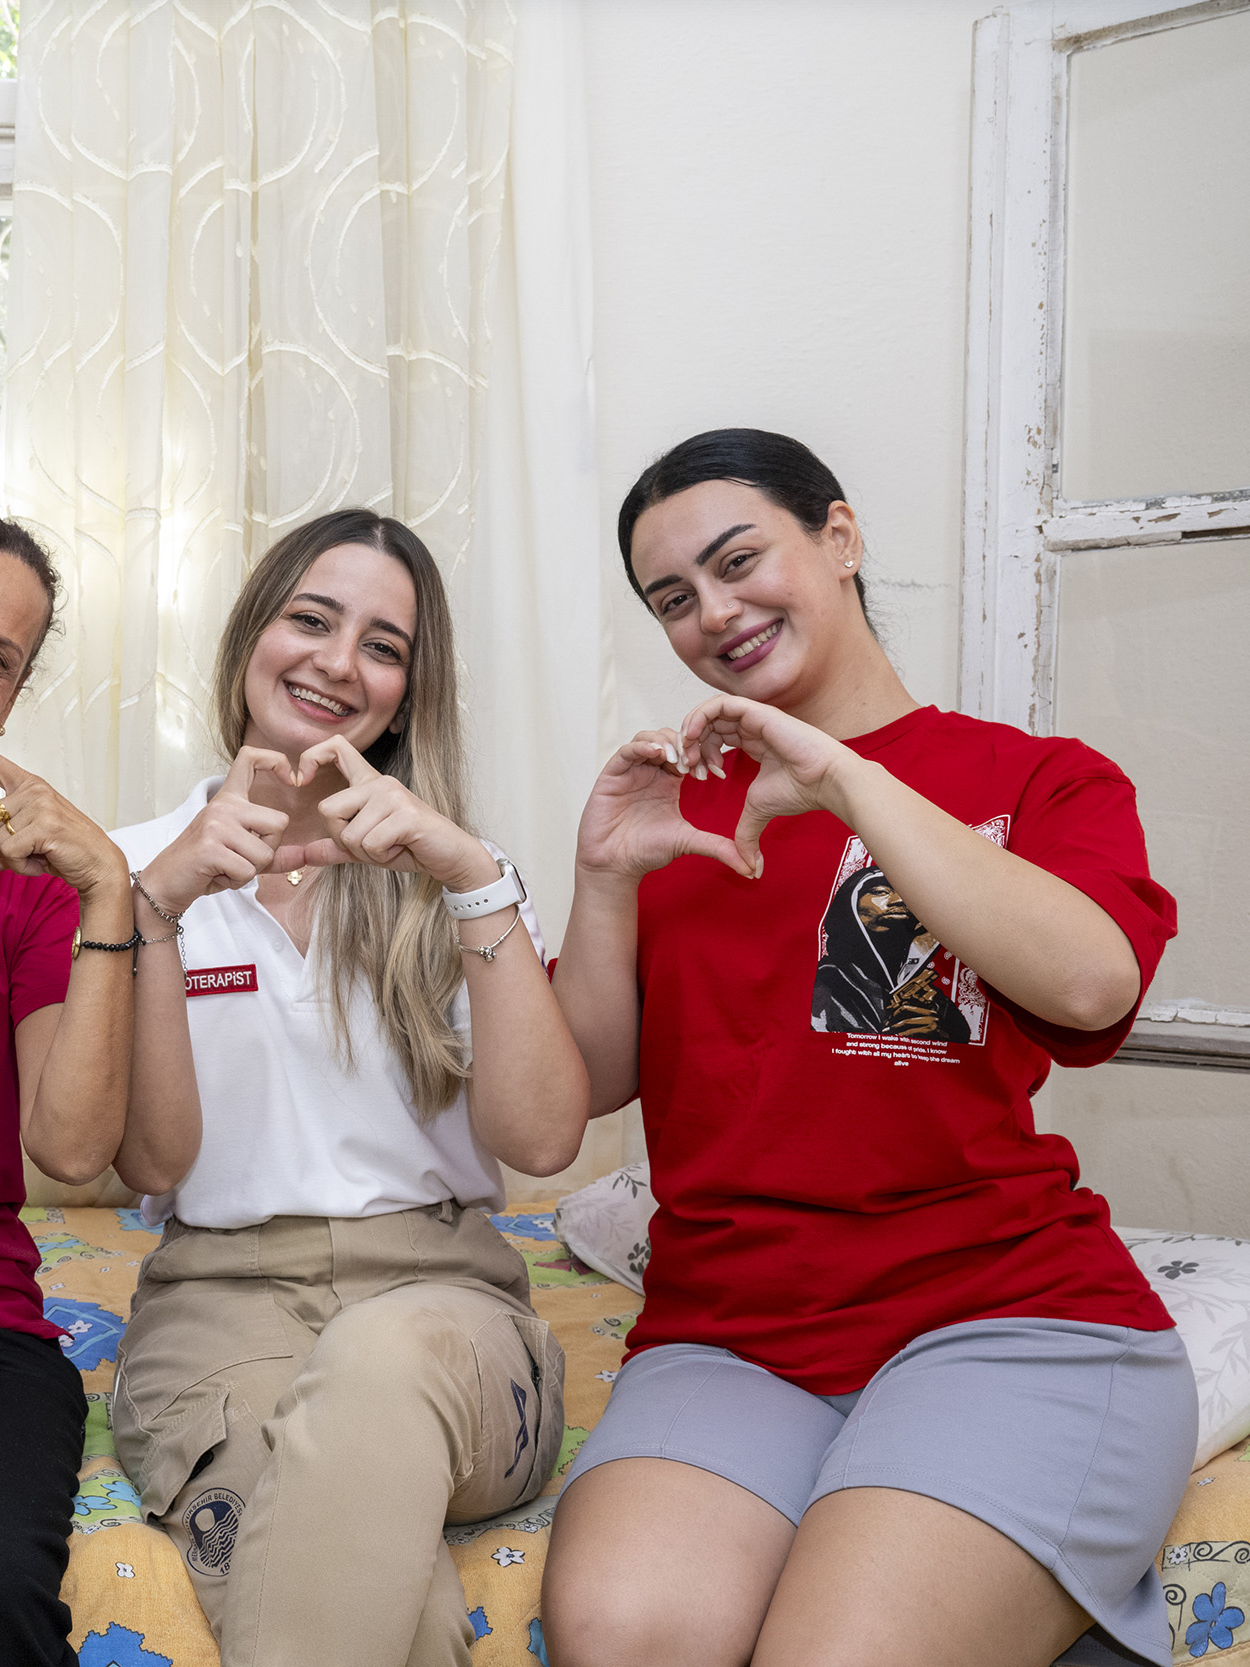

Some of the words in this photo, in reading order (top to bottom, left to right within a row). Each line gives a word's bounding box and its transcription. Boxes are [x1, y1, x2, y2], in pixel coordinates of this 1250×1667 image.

[846, 1032, 877, 1040] Tomorrow
[859, 1042, 880, 1050] strong
[835, 1048, 857, 1056] fought
